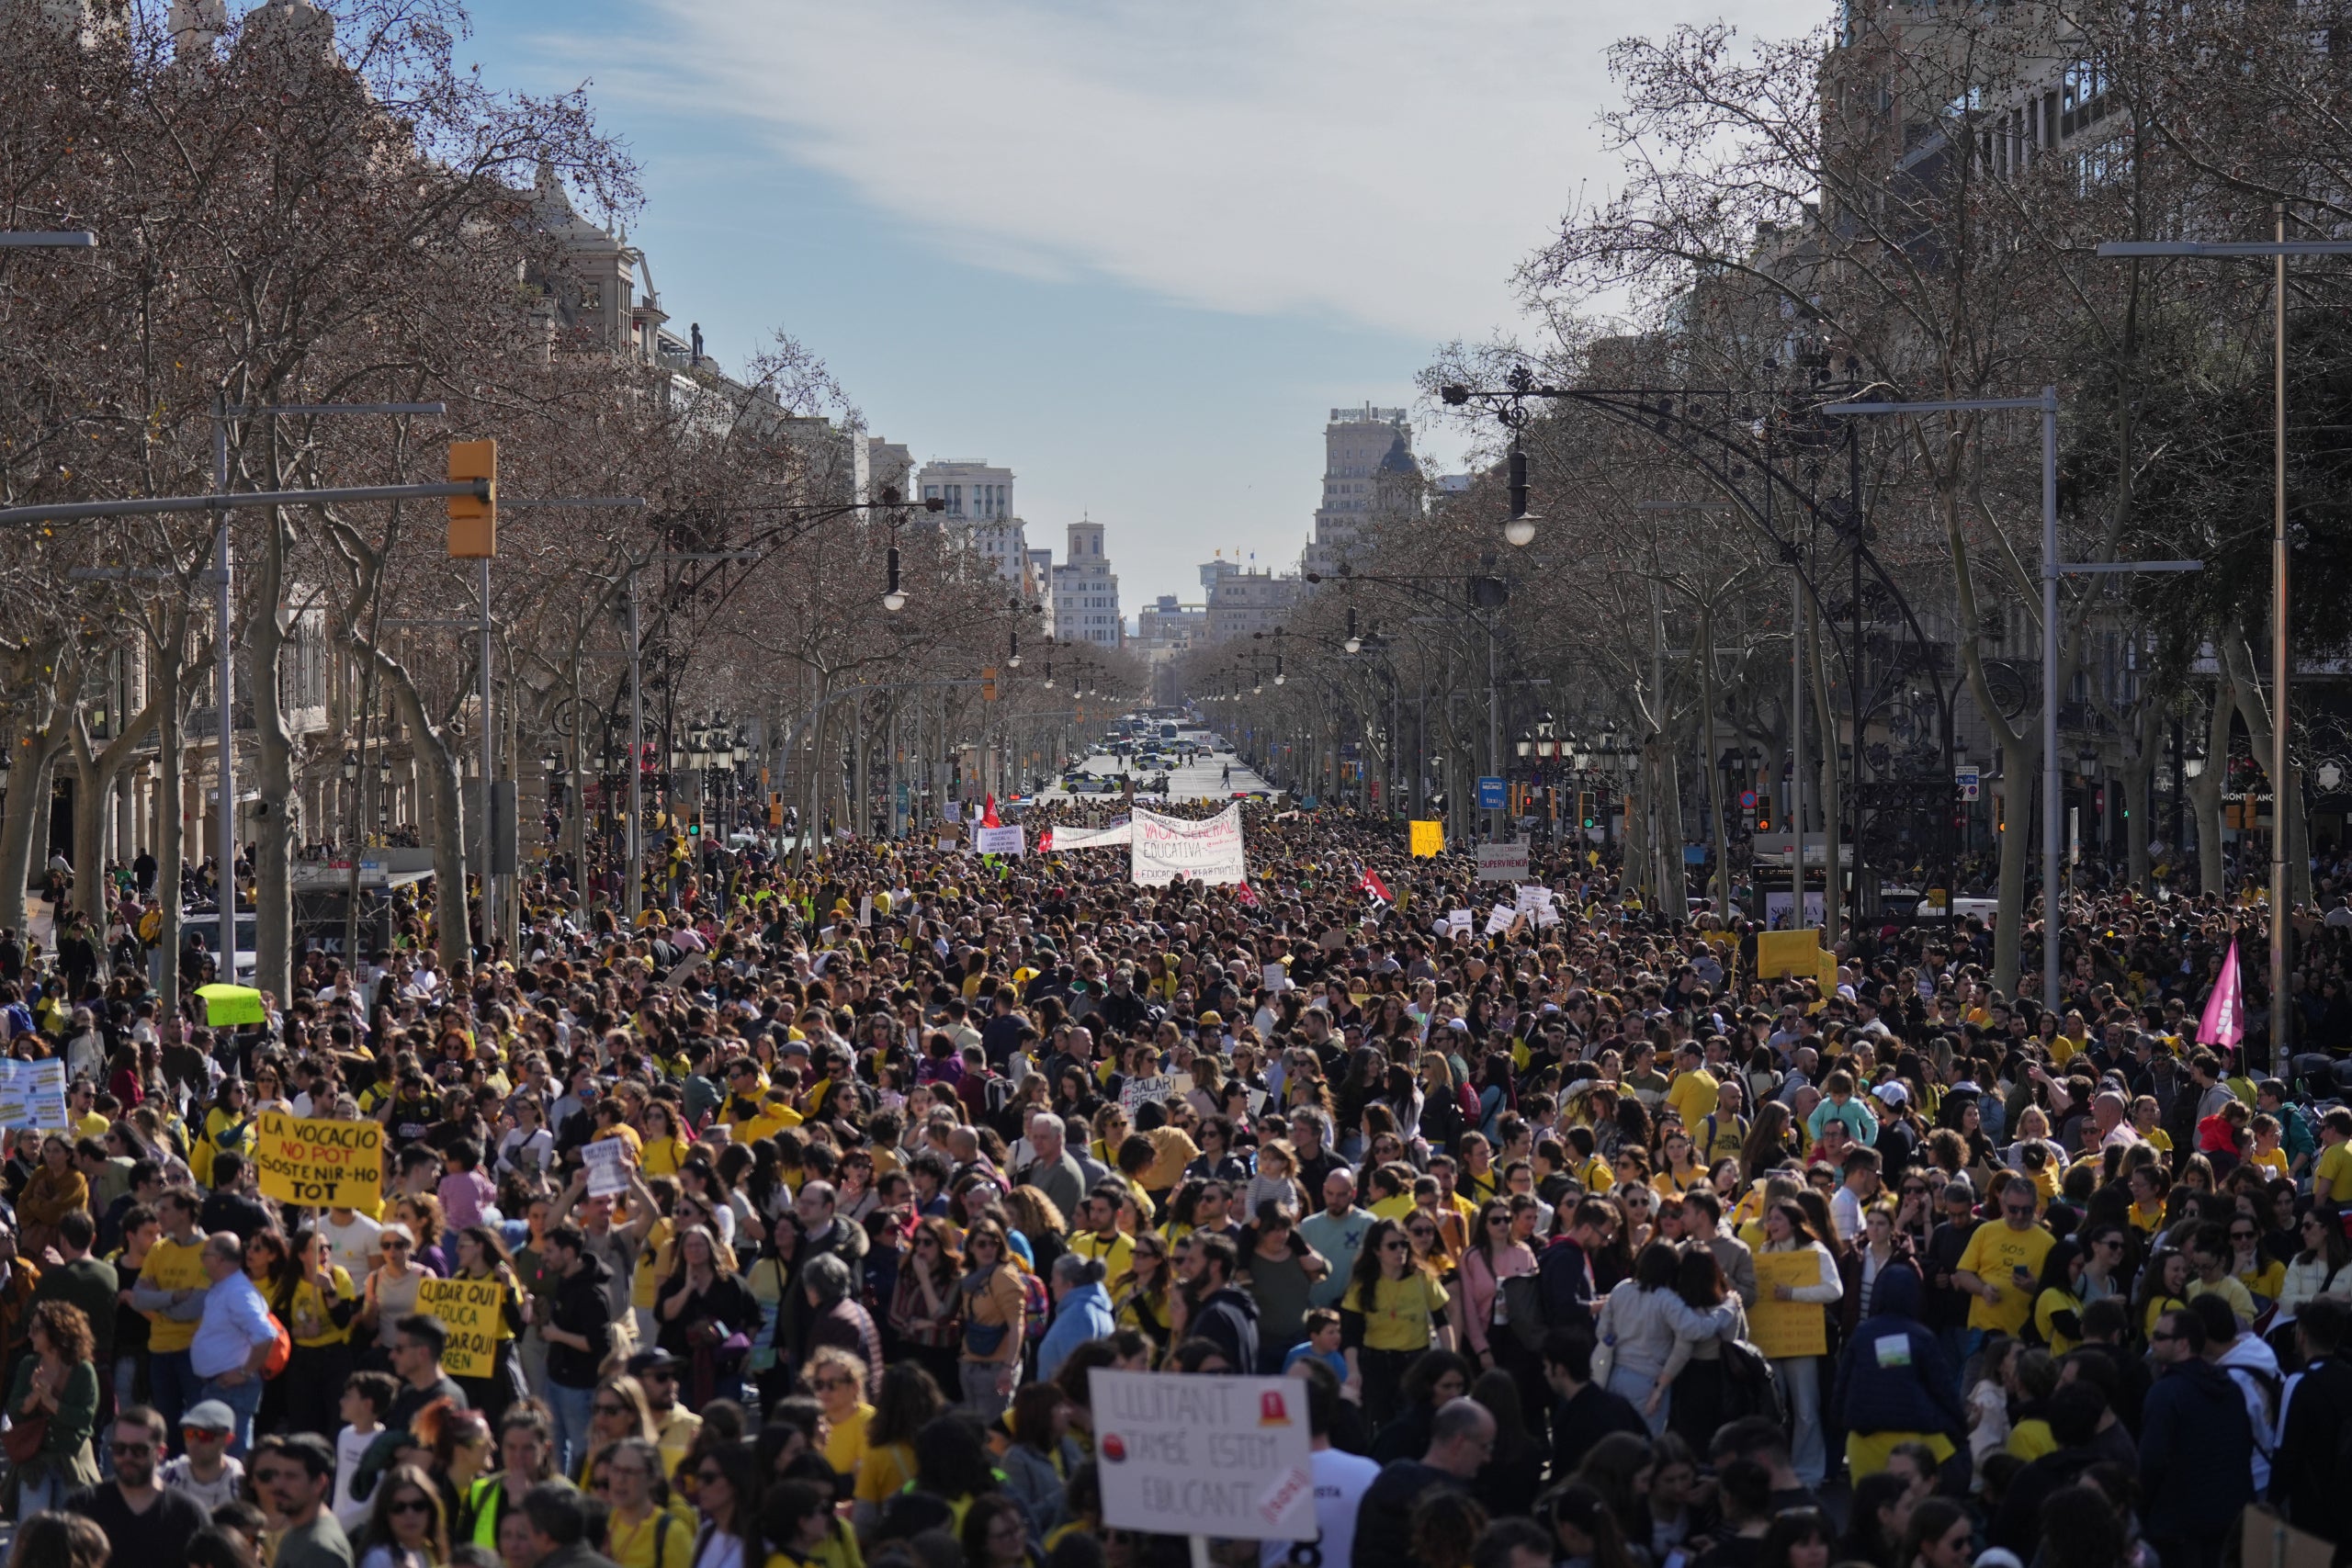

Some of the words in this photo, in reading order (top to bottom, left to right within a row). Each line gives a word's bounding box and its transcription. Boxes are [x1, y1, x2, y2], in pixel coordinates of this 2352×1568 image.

[2222, 792, 2274, 802] MONTANC
[1182, 820, 1235, 840] GENERAL
[1143, 841, 1202, 859] EDUCATIVA
[1771, 906, 1818, 916] SORLA
[324, 938, 368, 953] KC
[265, 1115, 284, 1136] LA
[280, 1141, 305, 1160] NO
[312, 1145, 356, 1165] POT
[260, 1154, 379, 1182] SOSTENIR-HO
[290, 1181, 338, 1201] TOT
[2000, 1243, 2025, 1256] SOS
[419, 1280, 462, 1303] CUIDAR
[468, 1284, 496, 1306] QUI
[2243, 1279, 2258, 1289] OS
[435, 1303, 478, 1325] EDUCA
[471, 1334, 493, 1355] QUI
[1125, 1427, 1190, 1465] TAMBÉ
[1209, 1433, 1280, 1470] ESTEM
